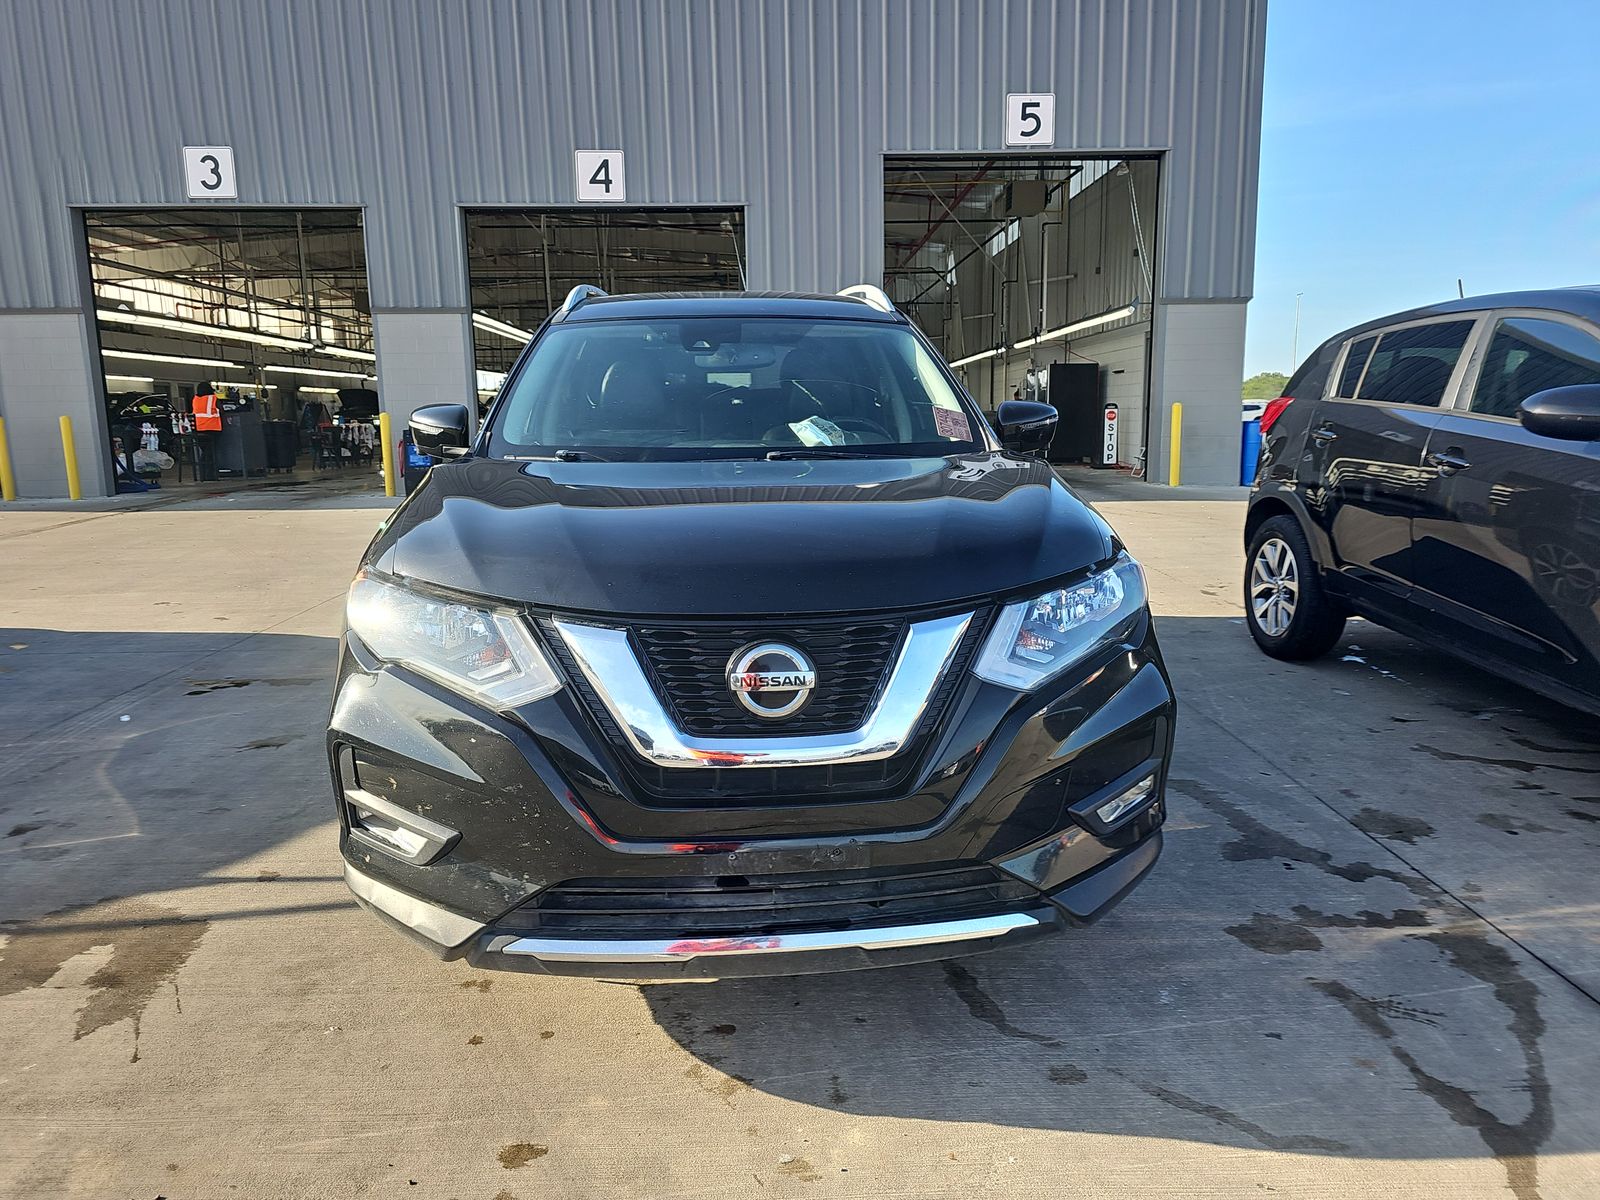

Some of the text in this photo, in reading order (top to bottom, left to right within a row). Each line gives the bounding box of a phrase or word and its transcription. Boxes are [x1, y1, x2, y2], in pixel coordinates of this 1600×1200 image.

[1020, 101, 1042, 137] 5
[199, 154, 222, 191] 3
[589, 158, 613, 194] 4
[1107, 423, 1115, 461] STOP
[740, 675, 806, 688] NISSAN
